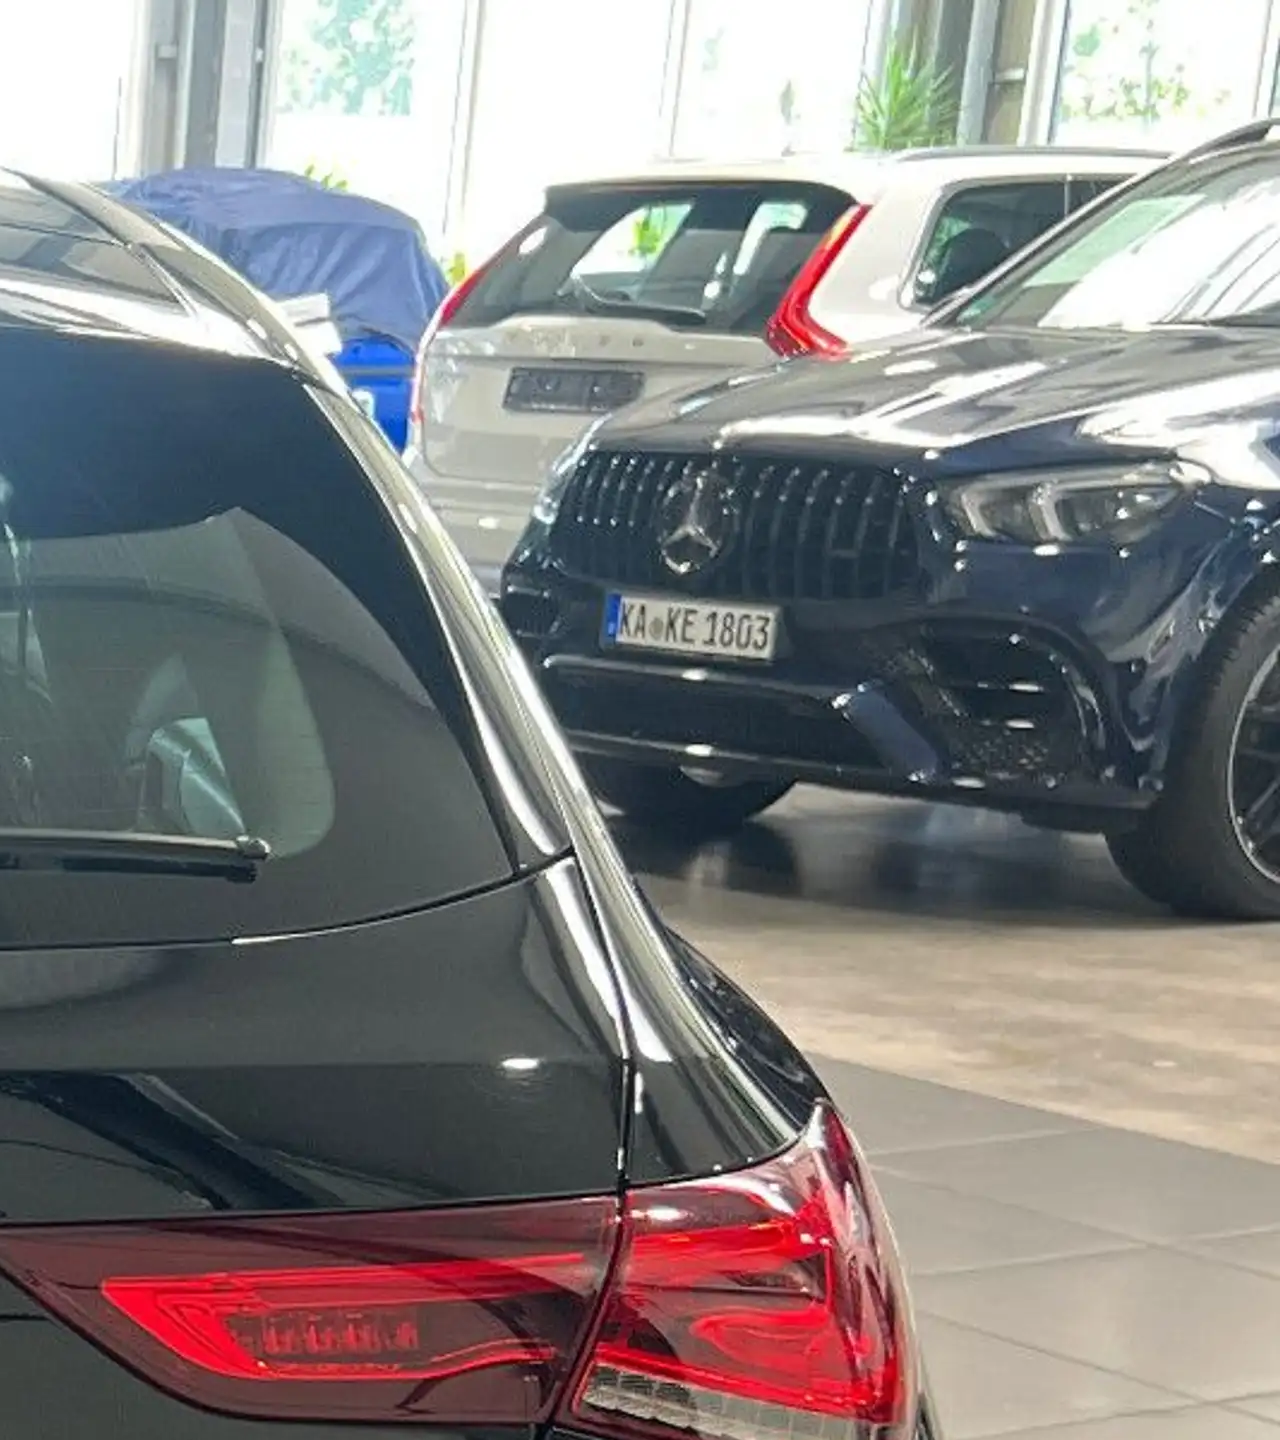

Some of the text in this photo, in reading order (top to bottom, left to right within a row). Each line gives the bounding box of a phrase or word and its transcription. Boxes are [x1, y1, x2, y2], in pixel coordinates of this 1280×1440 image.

[619, 603, 646, 639] KA
[665, 606, 698, 645] KE
[703, 611, 771, 650] 1803
